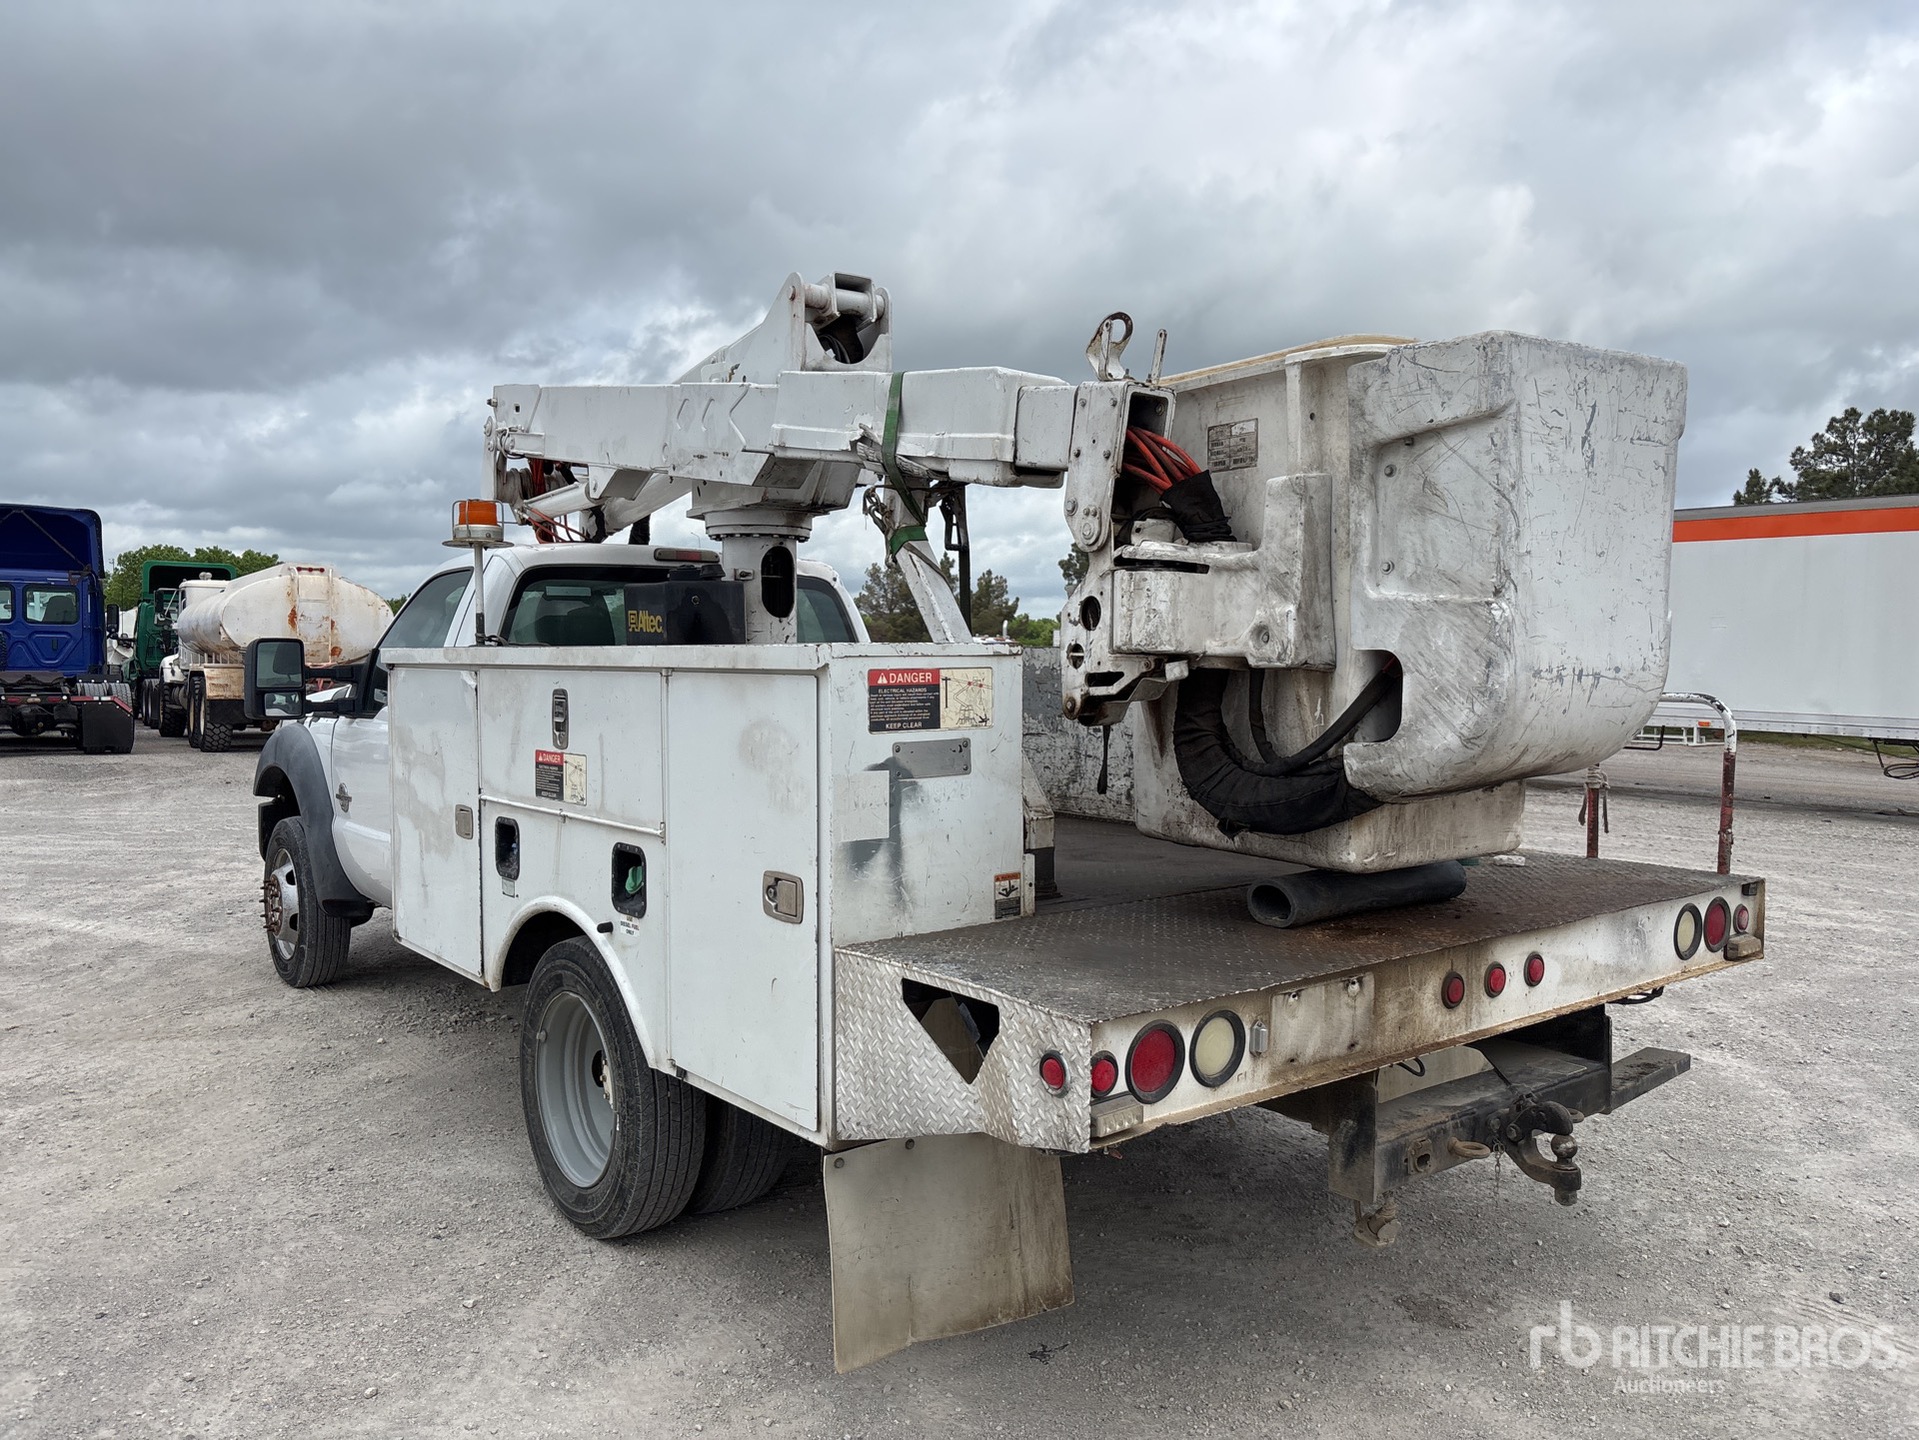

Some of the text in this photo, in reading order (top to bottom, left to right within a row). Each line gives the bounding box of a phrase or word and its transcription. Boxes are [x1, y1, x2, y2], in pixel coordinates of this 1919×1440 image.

[638, 610, 664, 633] Altec
[889, 672, 933, 684] DANGER
[885, 721, 923, 730] KEEP CLEAR
[542, 753, 561, 764] DANGER
